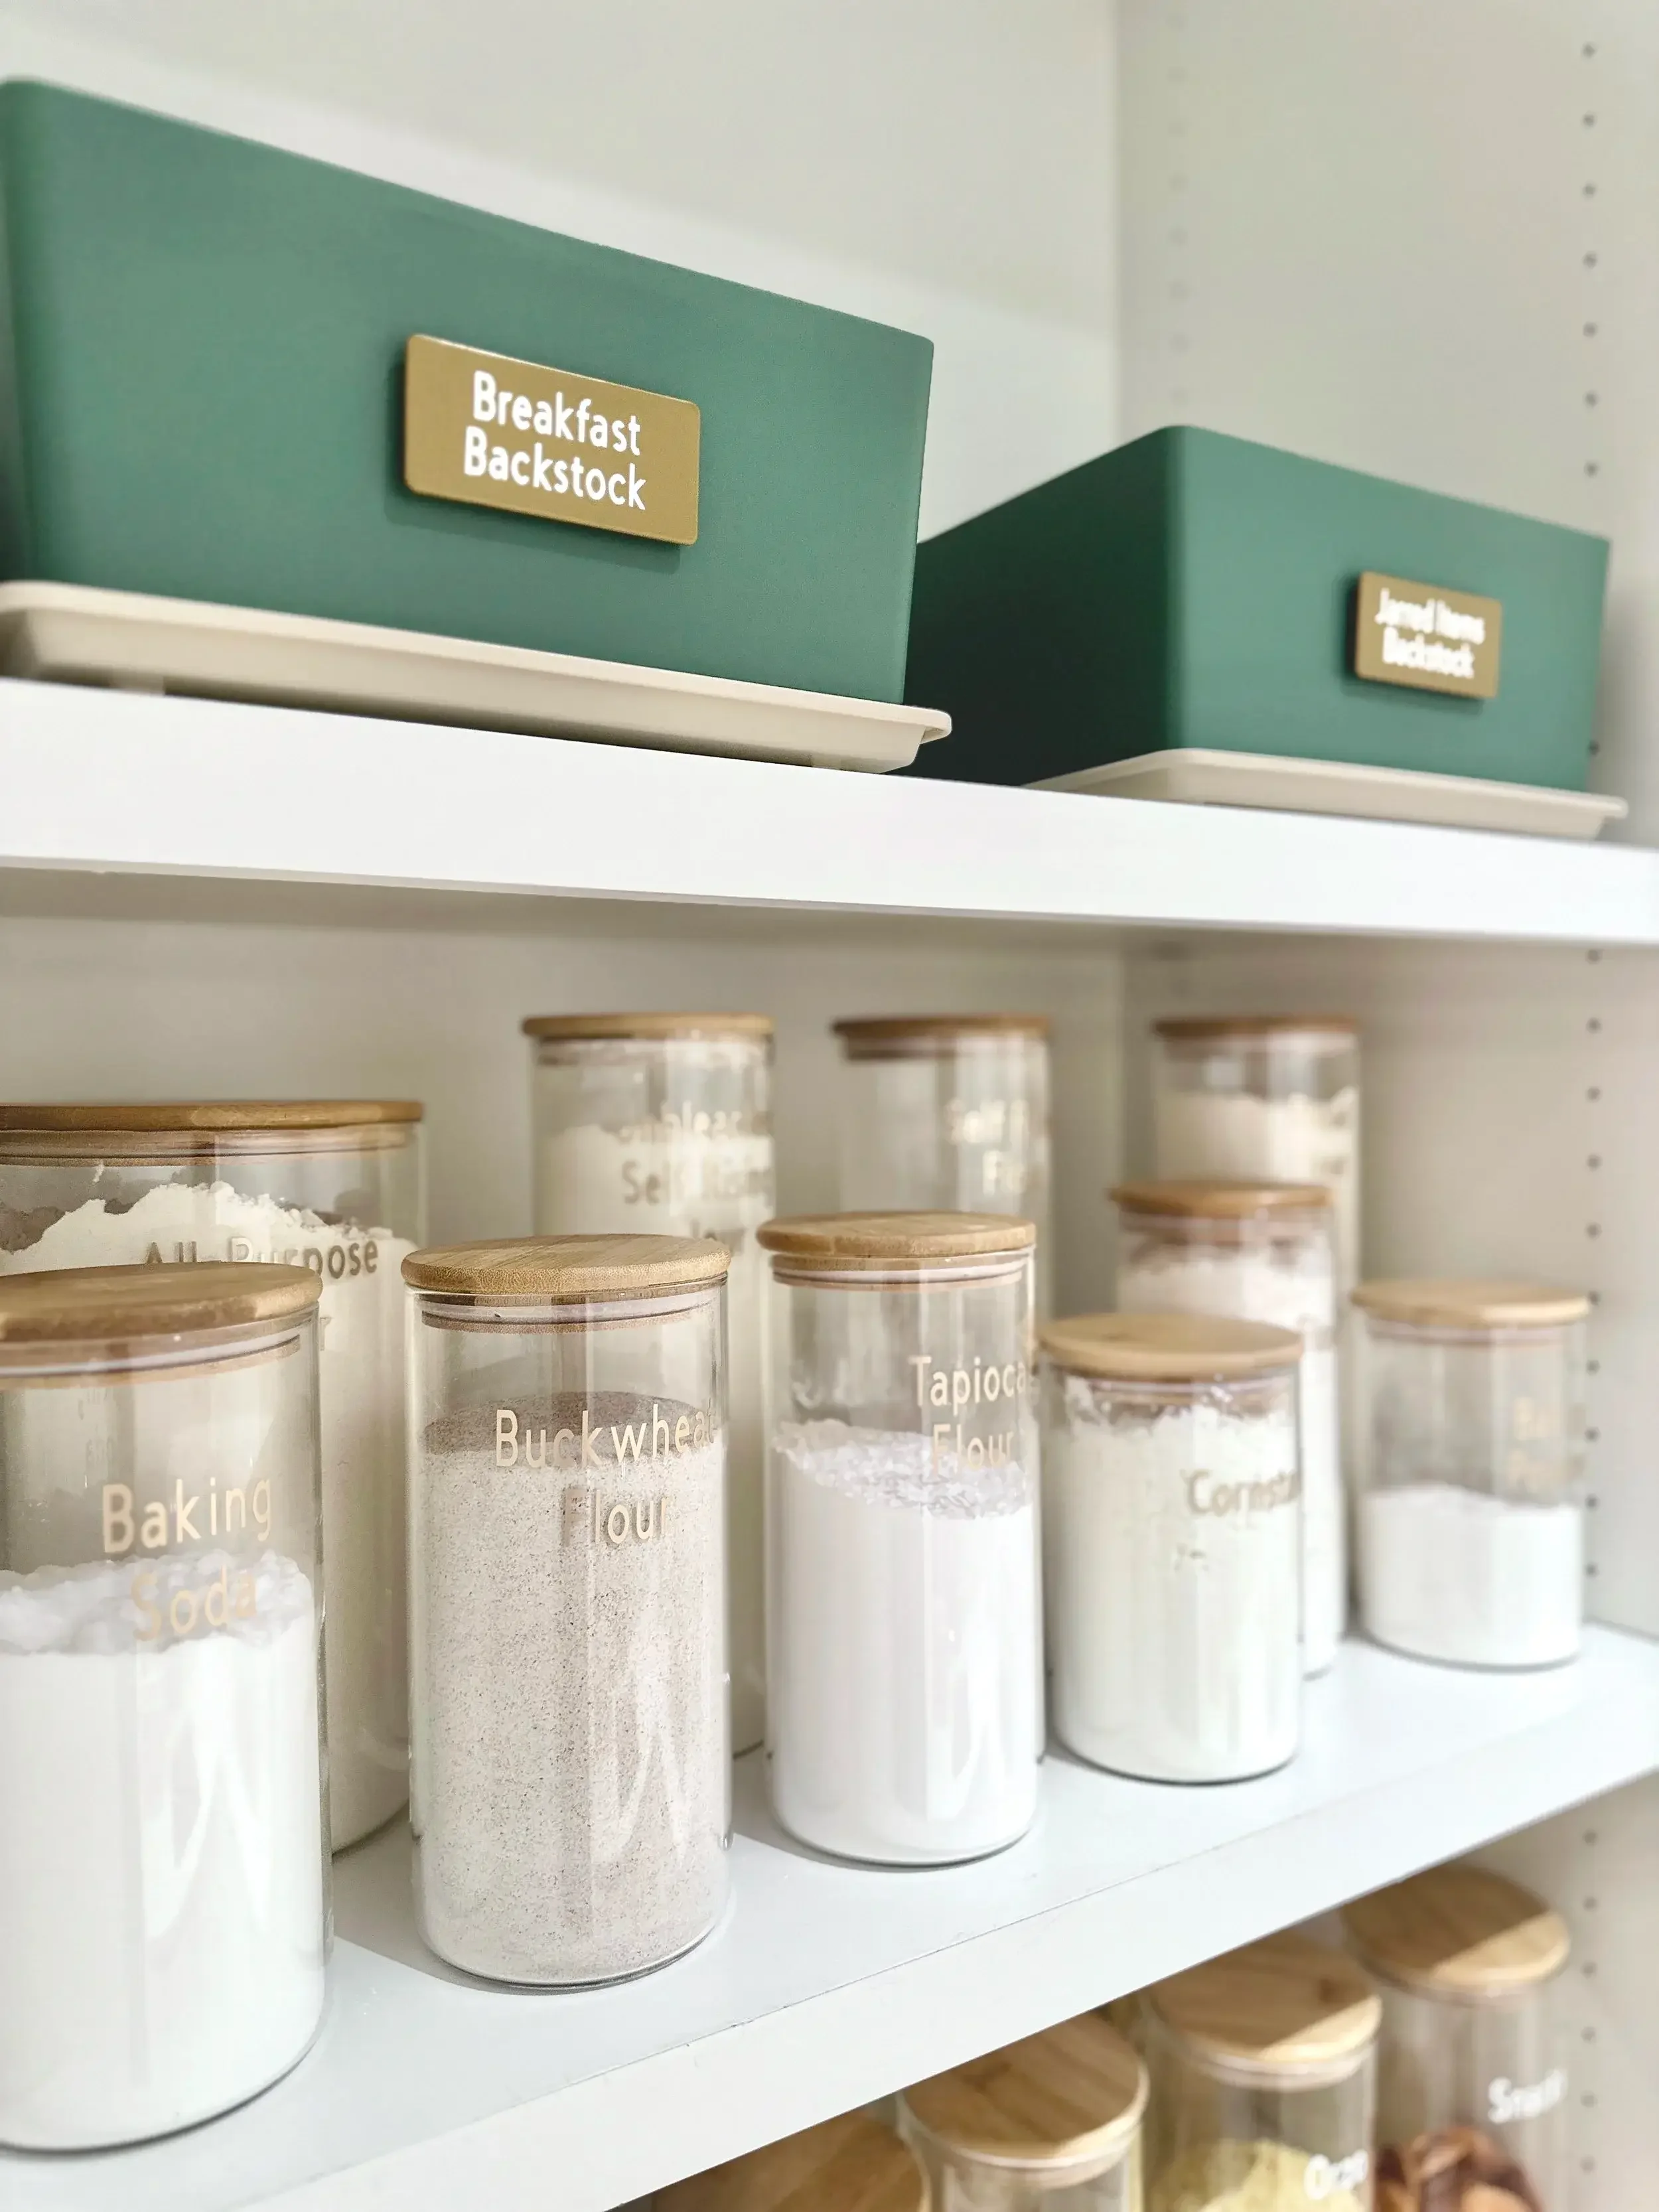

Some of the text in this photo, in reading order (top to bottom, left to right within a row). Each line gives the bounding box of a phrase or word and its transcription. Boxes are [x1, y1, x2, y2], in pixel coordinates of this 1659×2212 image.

[472, 370, 640, 456] Breakfast
[464, 425, 646, 511] Backstock
[907, 1355, 1027, 1416] Tapioca
[933, 1423, 1013, 1477] Flour
[102, 1477, 271, 1554] Baking
[561, 1488, 668, 1546] Flour
[130, 1563, 257, 1642] Soda
